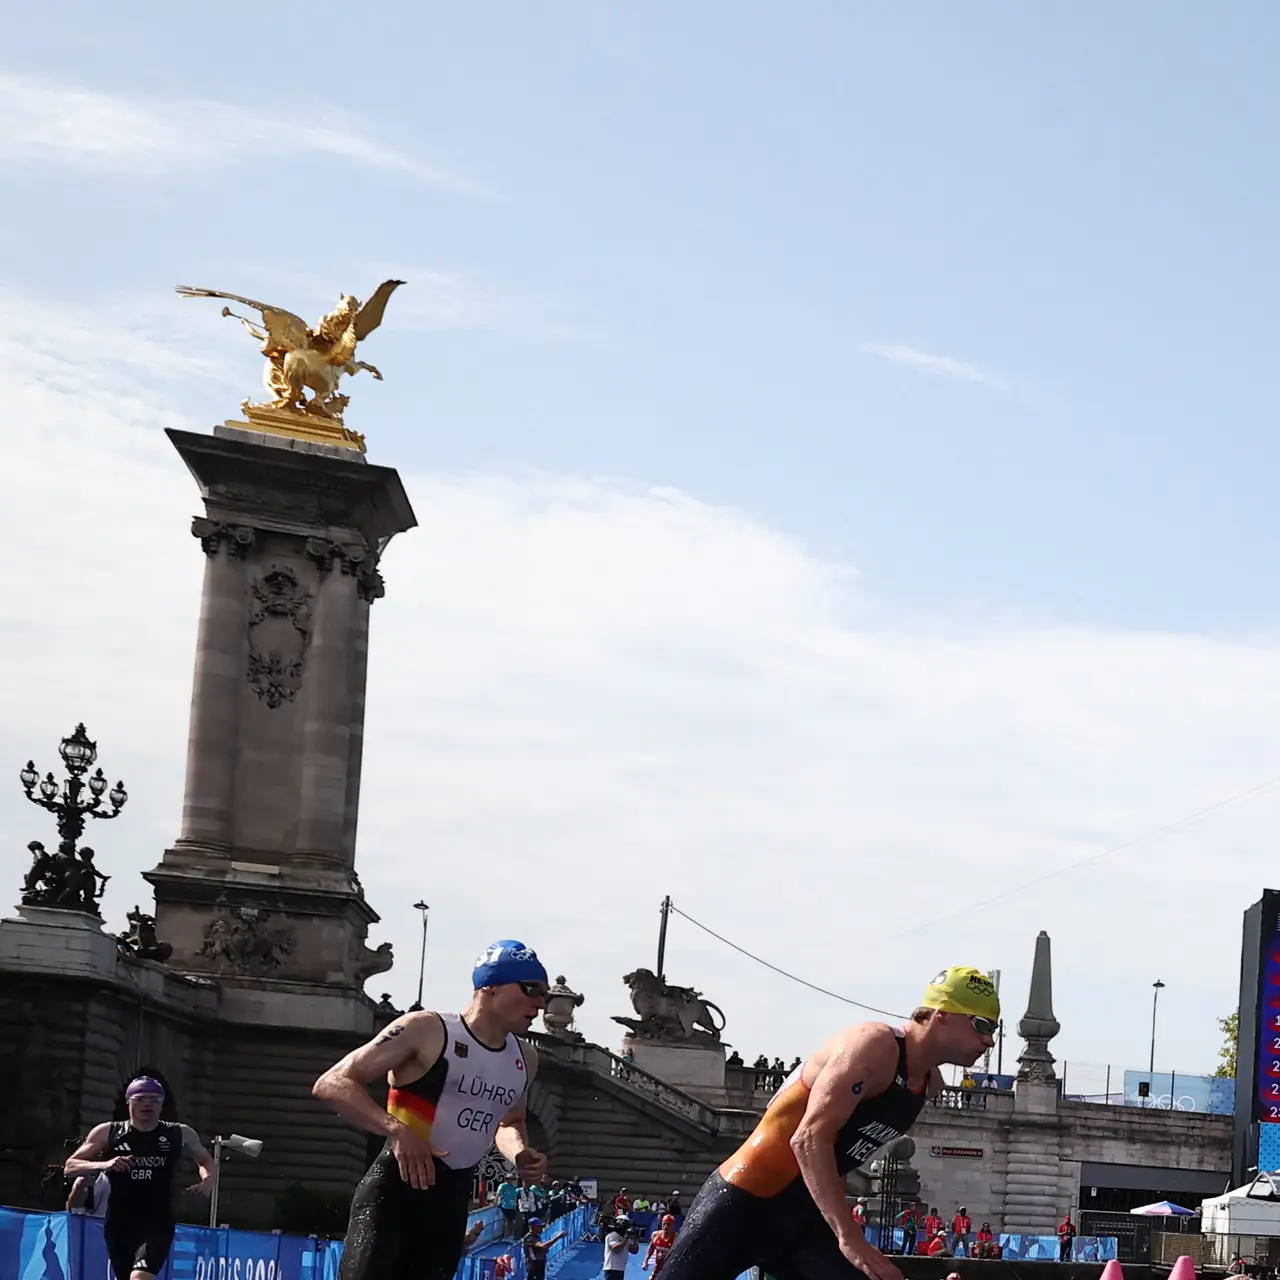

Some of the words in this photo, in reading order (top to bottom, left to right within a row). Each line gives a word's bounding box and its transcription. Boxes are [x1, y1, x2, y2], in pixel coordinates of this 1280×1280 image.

[458, 1075, 516, 1106] LÜHRS
[457, 1108, 494, 1134] GER
[135, 1156, 167, 1167] KINSON
[131, 1169, 153, 1180] GBR
